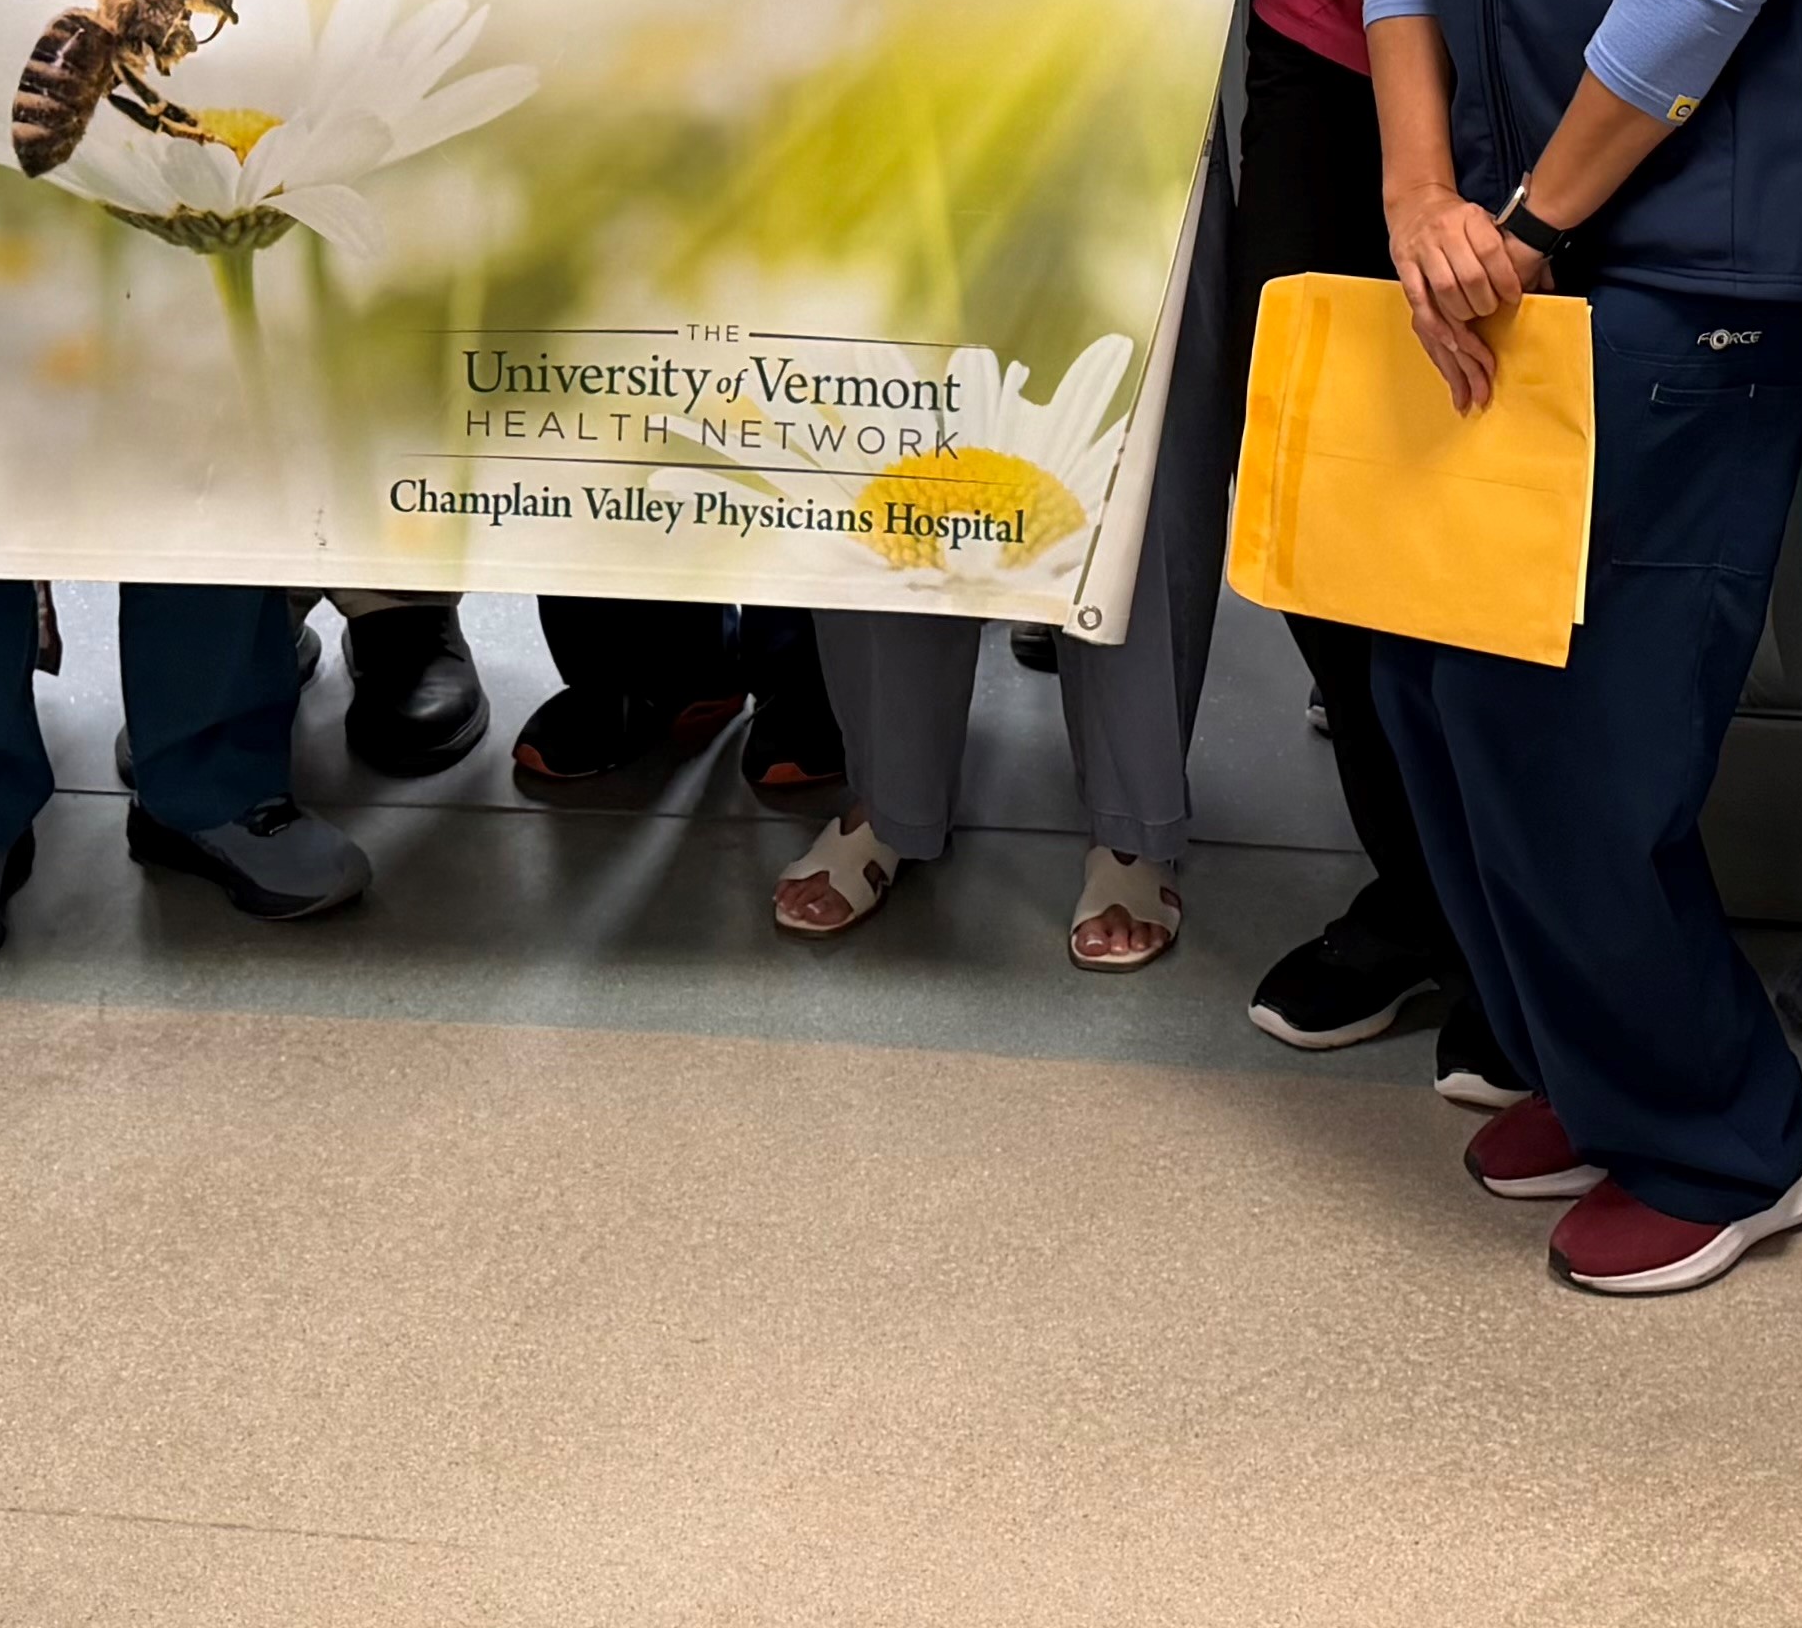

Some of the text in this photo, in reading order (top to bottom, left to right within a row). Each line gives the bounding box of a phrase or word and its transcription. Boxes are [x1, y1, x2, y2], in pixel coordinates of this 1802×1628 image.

[687, 324, 738, 342] THE
[1697, 329, 1762, 350] FORCE
[463, 350, 960, 413] University of Vermont
[467, 412, 958, 460] HEALTH NETWORK
[390, 479, 1024, 552] Champlain Valley Physicians Hospital
